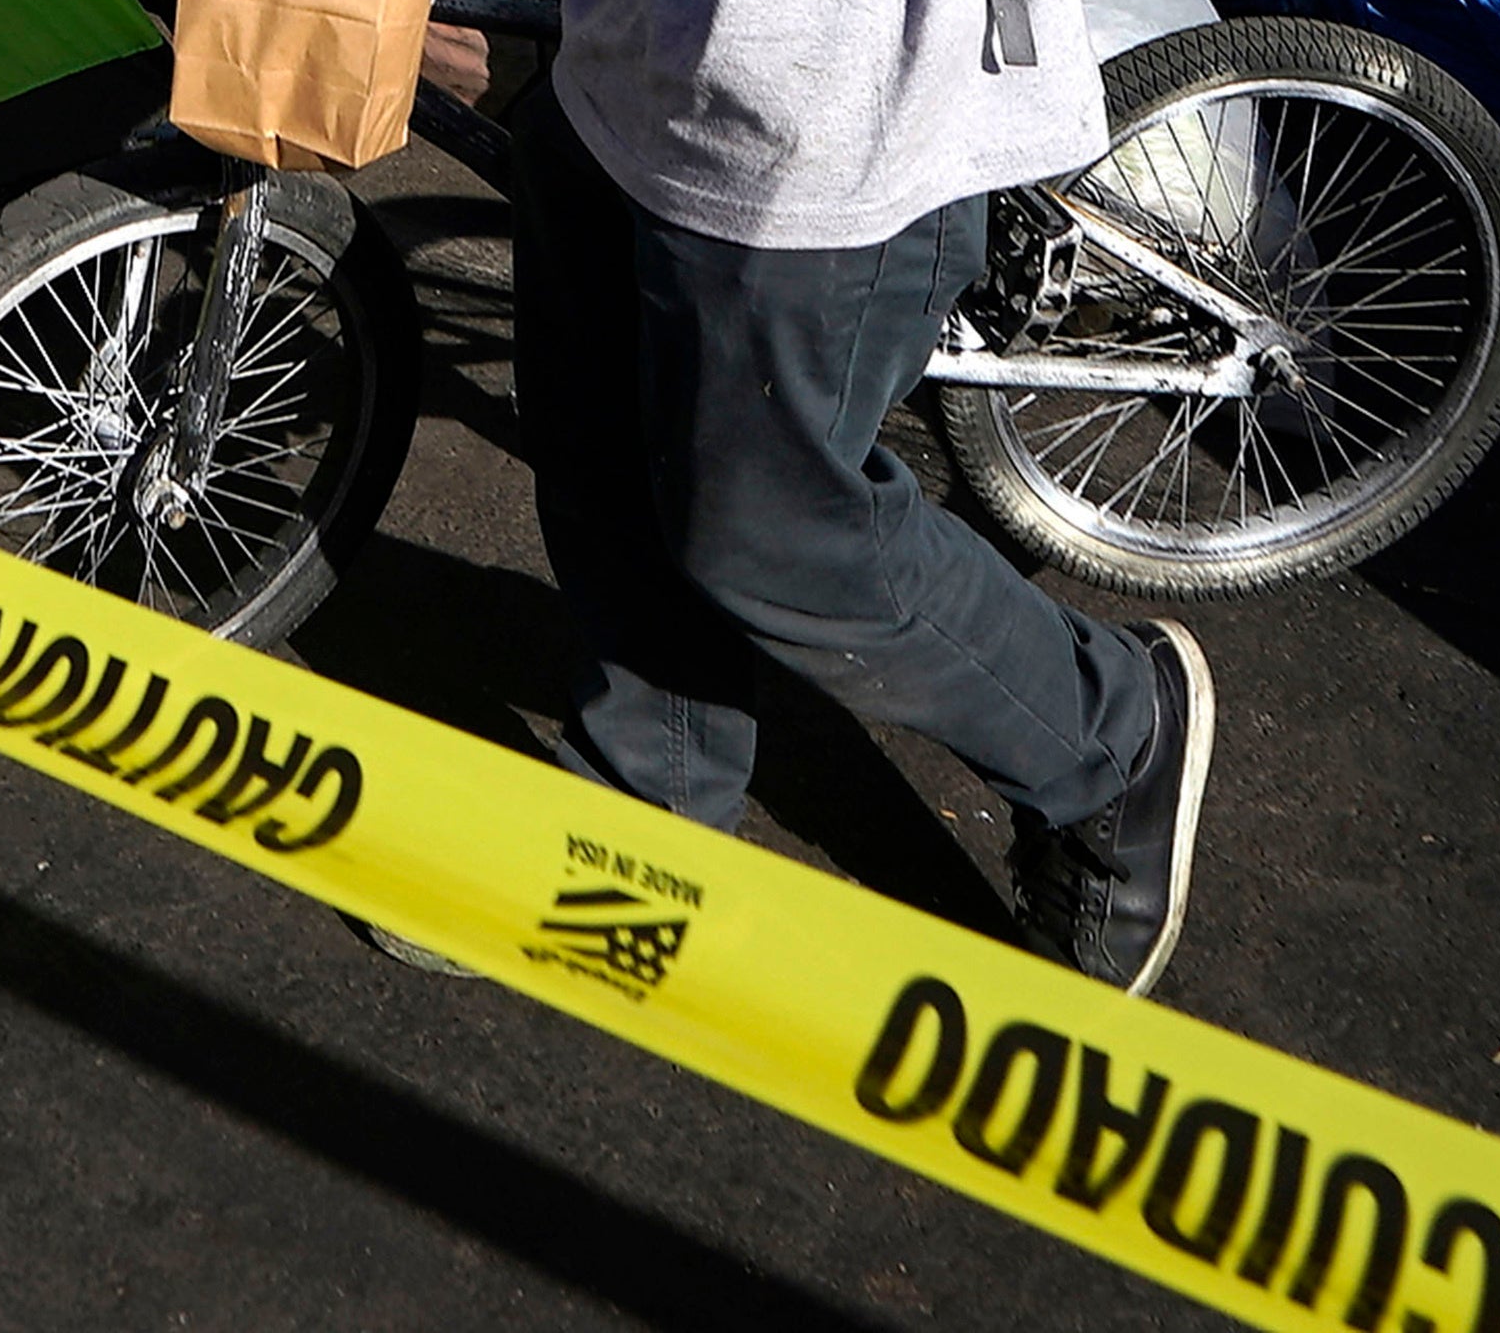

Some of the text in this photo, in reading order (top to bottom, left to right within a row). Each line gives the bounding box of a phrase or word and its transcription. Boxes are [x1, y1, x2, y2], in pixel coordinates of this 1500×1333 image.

[567, 833, 703, 908] MADE IN USA
